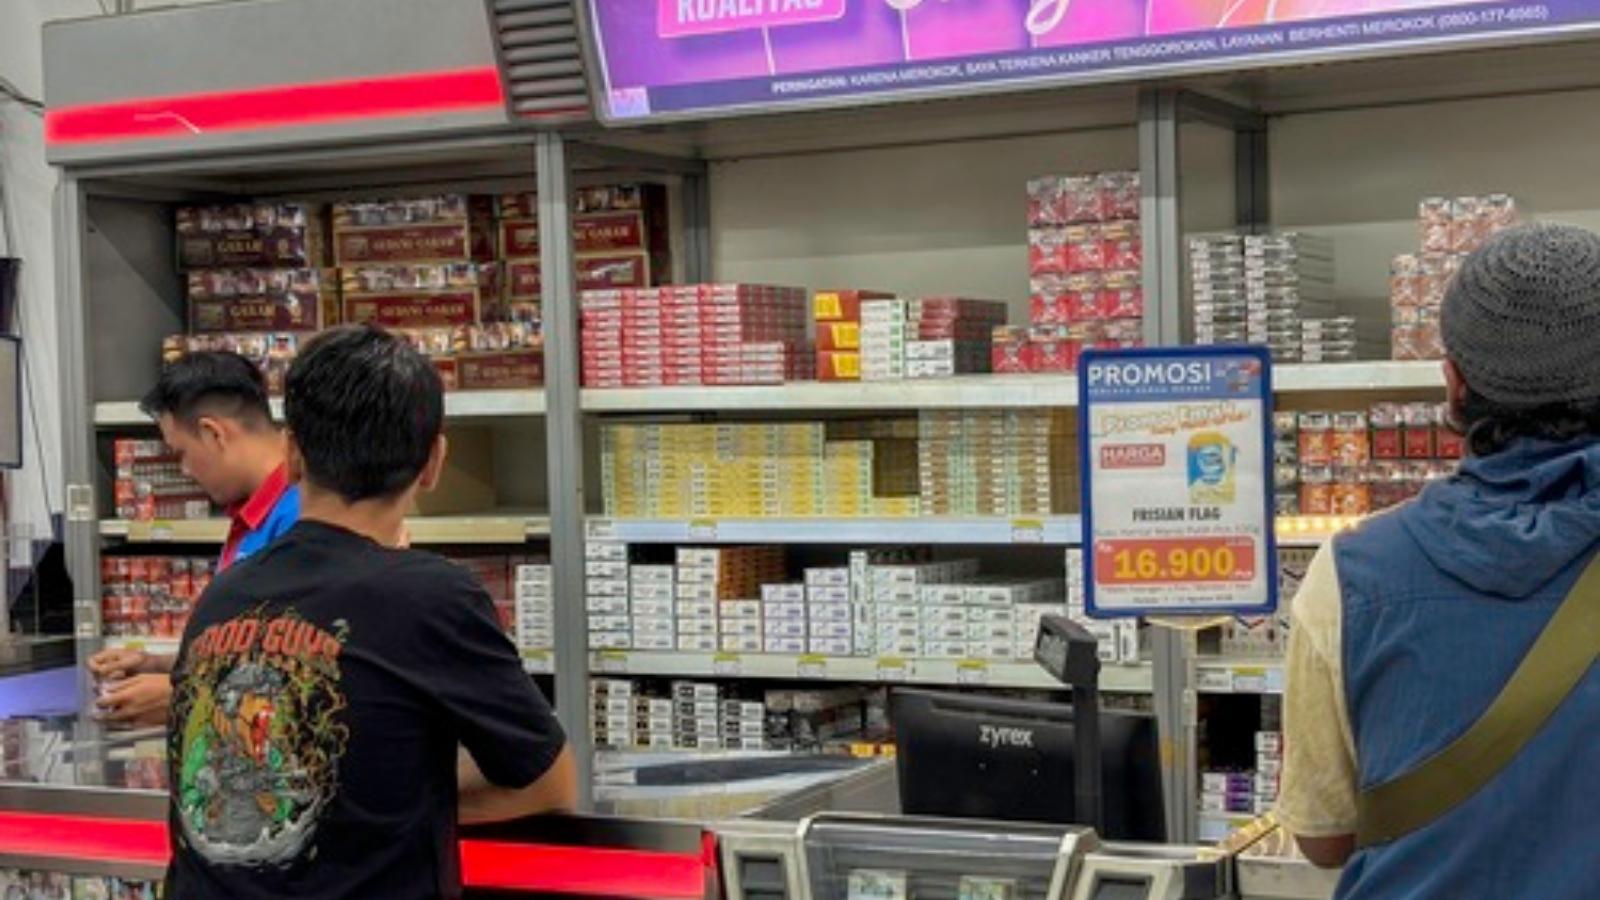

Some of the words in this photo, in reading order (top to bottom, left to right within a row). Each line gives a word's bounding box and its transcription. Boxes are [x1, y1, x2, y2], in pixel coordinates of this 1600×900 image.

[678, 0, 823, 23] KUALI
[851, 72, 897, 85] KARENA
[999, 54, 1054, 71] TERKENA
[1058, 49, 1111, 65] KANKER
[1222, 31, 1284, 48] LAYANAN
[1289, 24, 1360, 41] BERHENTI
[1087, 362, 1211, 386] PROMOSI
[1102, 446, 1163, 465] HARGA
[1132, 507, 1185, 522] FRISIAN
[1188, 506, 1222, 520] FLAG
[1113, 545, 1235, 579] 16.900
[979, 724, 1034, 748] zyrex
